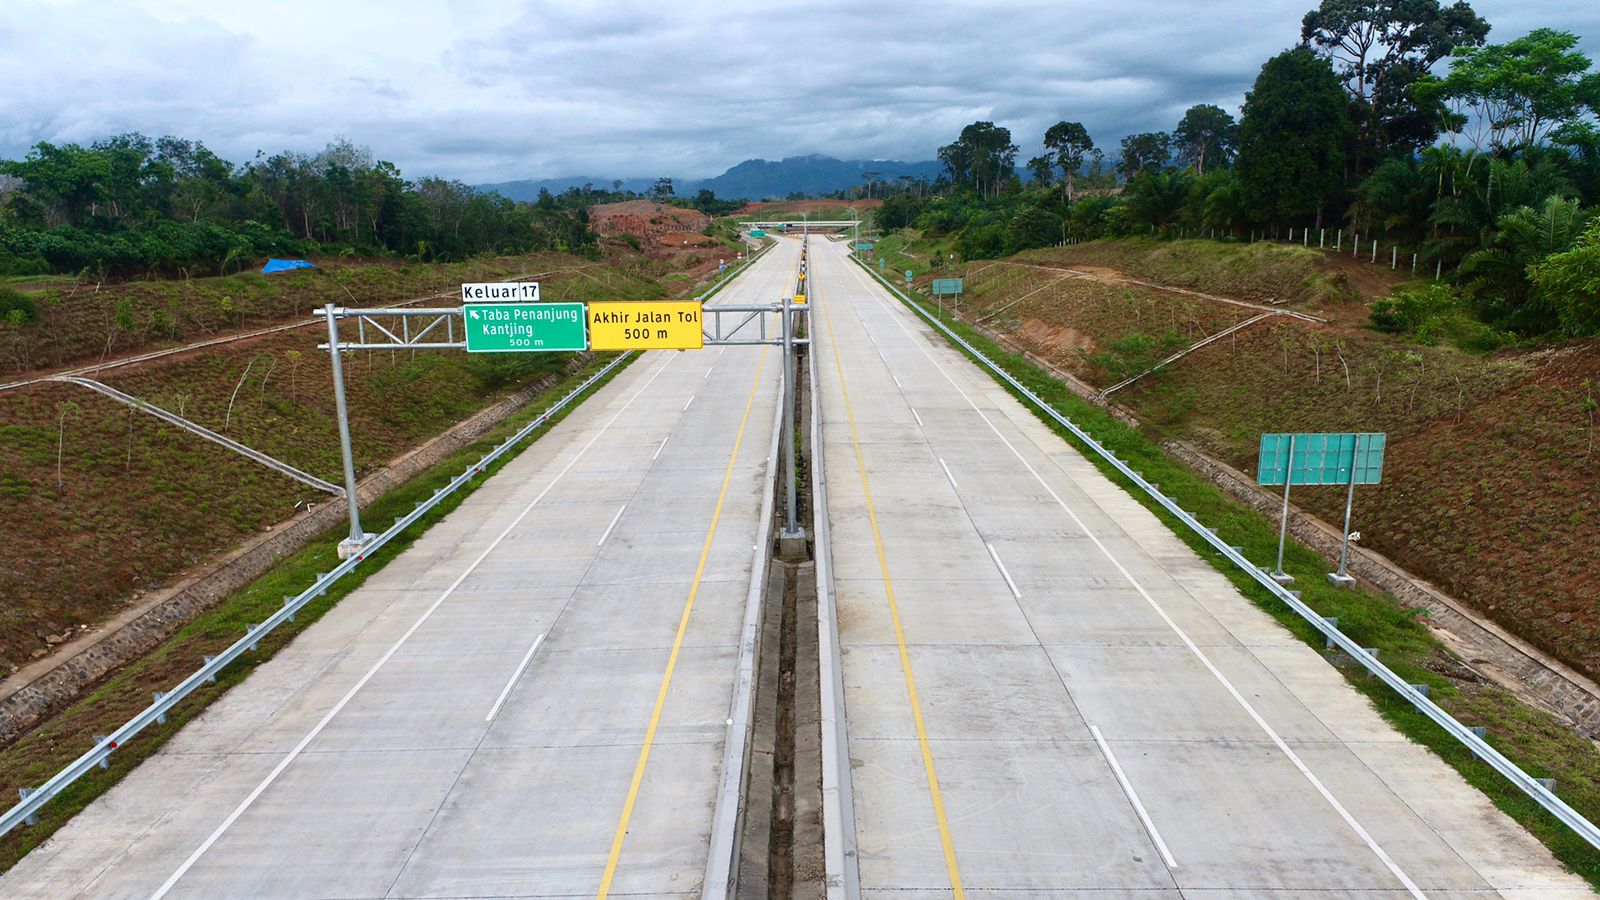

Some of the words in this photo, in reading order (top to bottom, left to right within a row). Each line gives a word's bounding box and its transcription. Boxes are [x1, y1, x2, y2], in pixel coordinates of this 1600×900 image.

[464, 285, 517, 299] Keluar
[521, 285, 537, 298] 17
[481, 309, 510, 321] Taba
[514, 308, 578, 323] Penanjung
[593, 311, 630, 324] Akhir
[635, 311, 671, 323] Jalan
[677, 310, 698, 323] Tol
[482, 323, 533, 337] Kantjing
[624, 328, 650, 340] 500
[657, 329, 668, 339] m
